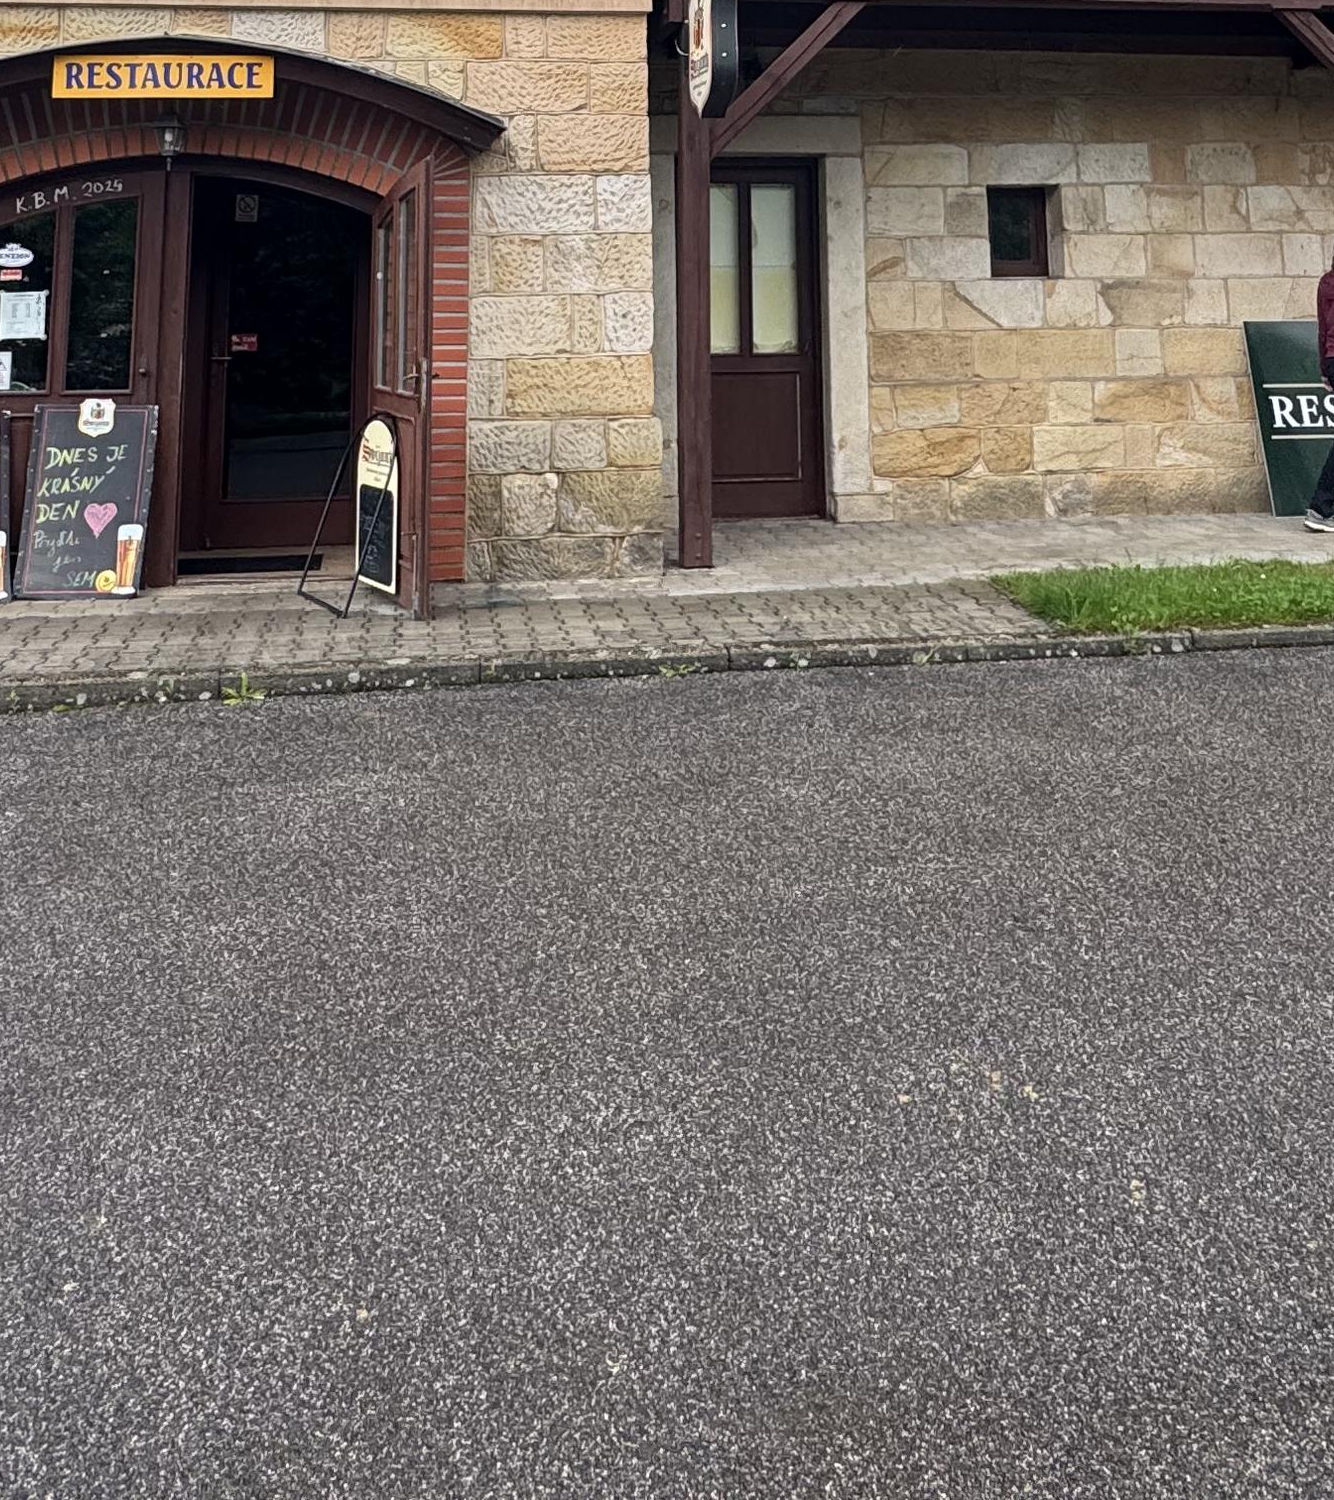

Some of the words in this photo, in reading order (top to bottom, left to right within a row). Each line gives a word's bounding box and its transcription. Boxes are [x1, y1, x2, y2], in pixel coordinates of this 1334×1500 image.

[65, 62, 264, 90] RESTAURACE
[44, 446, 98, 470] DNES
[106, 444, 128, 462] JE
[36, 500, 81, 523] DEN
[62, 570, 97, 589] SEM
